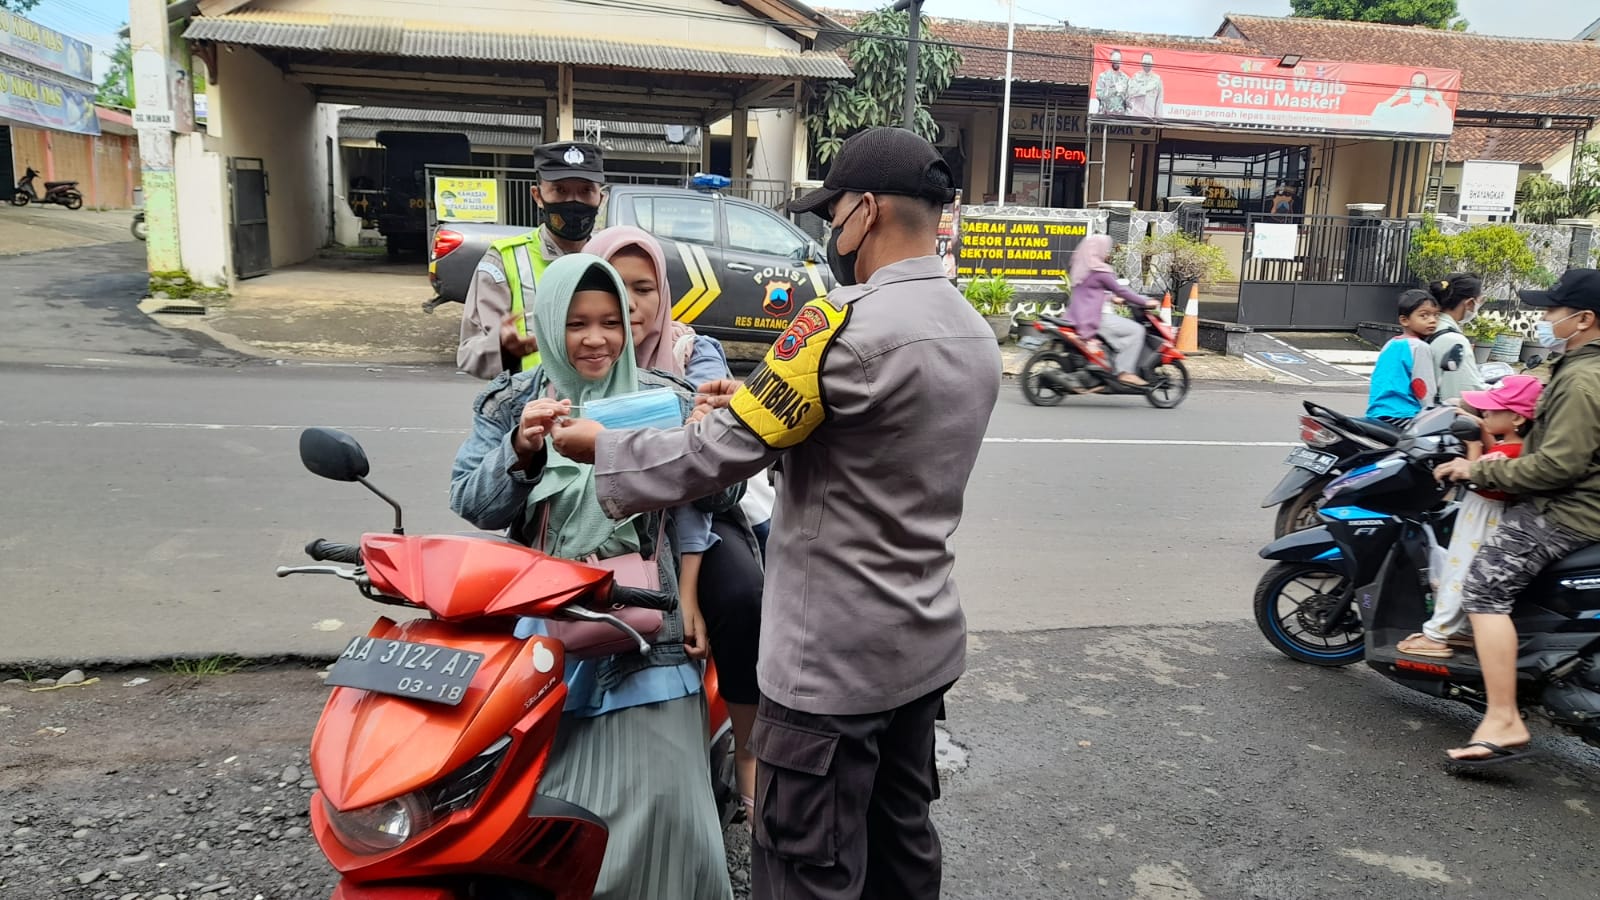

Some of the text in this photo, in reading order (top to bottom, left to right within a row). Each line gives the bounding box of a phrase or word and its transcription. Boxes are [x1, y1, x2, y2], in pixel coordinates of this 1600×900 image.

[1217, 73, 1347, 97] Semua Wajib
[1220, 89, 1340, 111] Pakai Masker!
[1168, 106, 1202, 118] Jangan
[1205, 109, 1237, 121] pernah
[960, 222, 1006, 234] DAERAH
[1010, 224, 1040, 235] JAWA
[1043, 224, 1086, 236] TENGAH
[963, 235, 1048, 248] RESOR BATANG
[959, 248, 1052, 261] SEKTOR BANDAR
[753, 266, 808, 286] POLISI
[735, 316, 753, 328] RES
[754, 317, 789, 330] BATANG
[340, 637, 481, 679] AA 3124 AT
